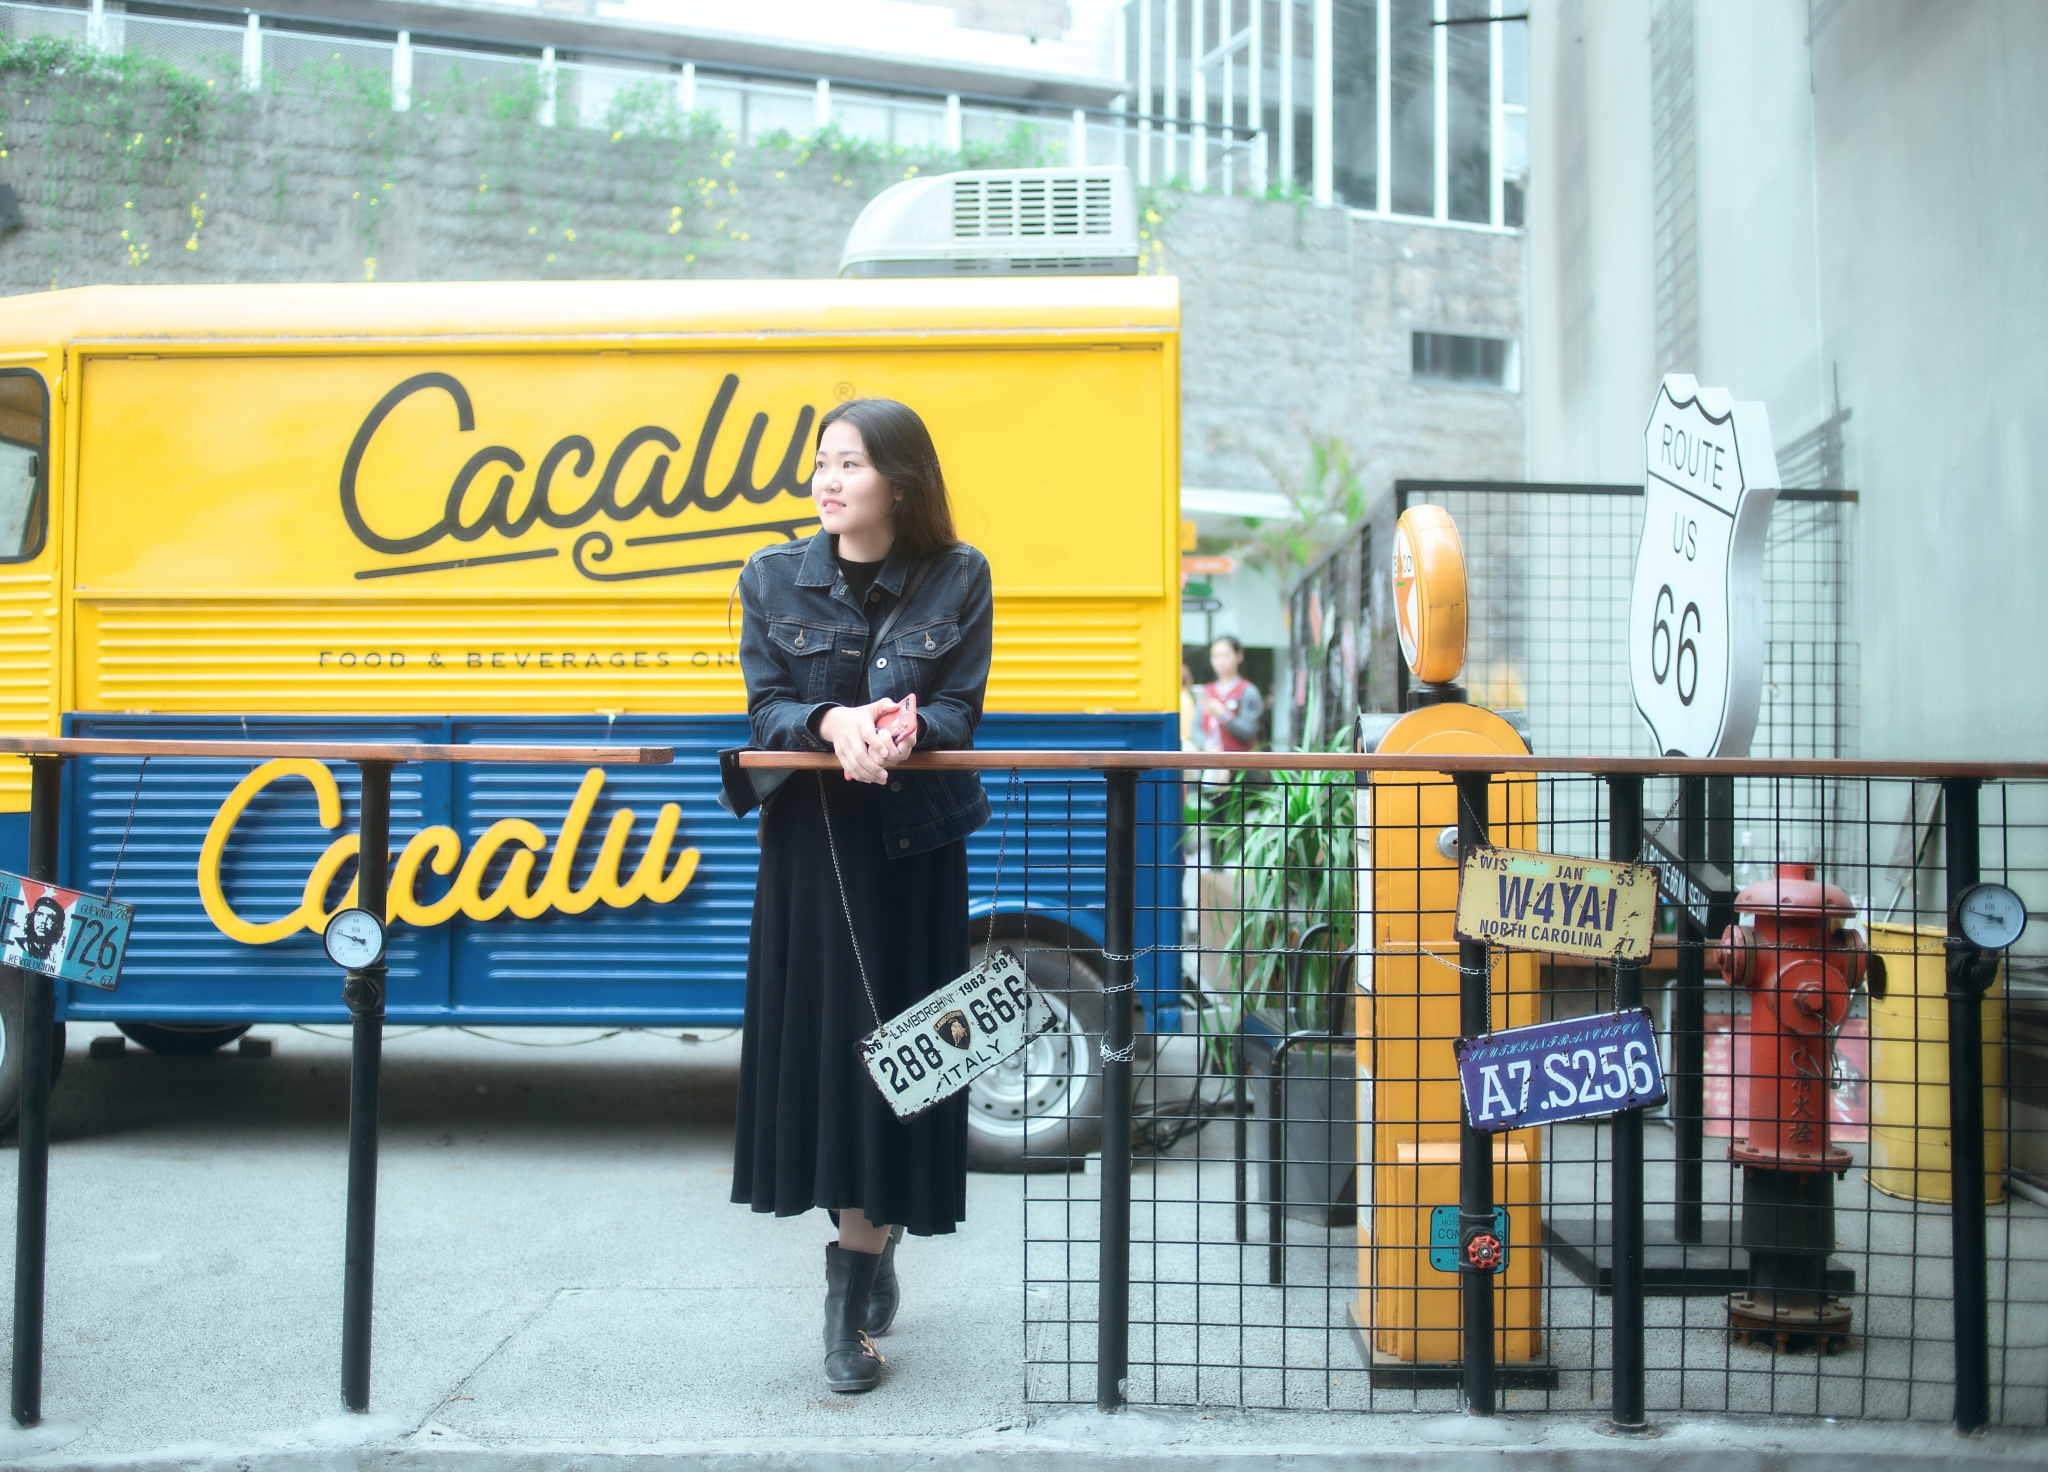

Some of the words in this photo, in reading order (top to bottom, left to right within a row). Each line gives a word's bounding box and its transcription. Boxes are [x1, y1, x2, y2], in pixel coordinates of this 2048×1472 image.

[340, 372, 816, 555] Cacalu
[1661, 423, 1725, 491] ROUTE
[1673, 511, 1698, 562] US
[319, 652, 405, 668] FOOD
[428, 652, 445, 668] &
[467, 652, 669, 668] BEVERAGES
[1652, 584, 1702, 706] 66
[198, 758, 699, 944] Cacalu
[1480, 855, 1508, 871] WIS
[1555, 865, 1583, 880] JAN
[1616, 873, 1634, 887] 53
[80, 903, 113, 920] GUEVARA
[116, 908, 128, 920] 28
[1498, 874, 1617, 931] W4YAI
[1670, 866, 1680, 898] 66
[1678, 872, 1710, 928] MSEUM
[66, 913, 119, 970] 726
[1480, 919, 1527, 939] NORTH
[1531, 925, 1602, 948] CAROLINA
[1617, 937, 1635, 951] 77
[8, 954, 56, 974] REVOLUCION
[867, 1039, 883, 1055] 66
[889, 992, 956, 1040] LAMBORGHINI
[958, 973, 986, 997] 1963
[992, 957, 1009, 974] 99
[878, 1033, 944, 1095] 288
[969, 974, 1033, 1035] 666
[943, 1038, 1002, 1086] ITALY
[1479, 1041, 1653, 1121] A7.S256
